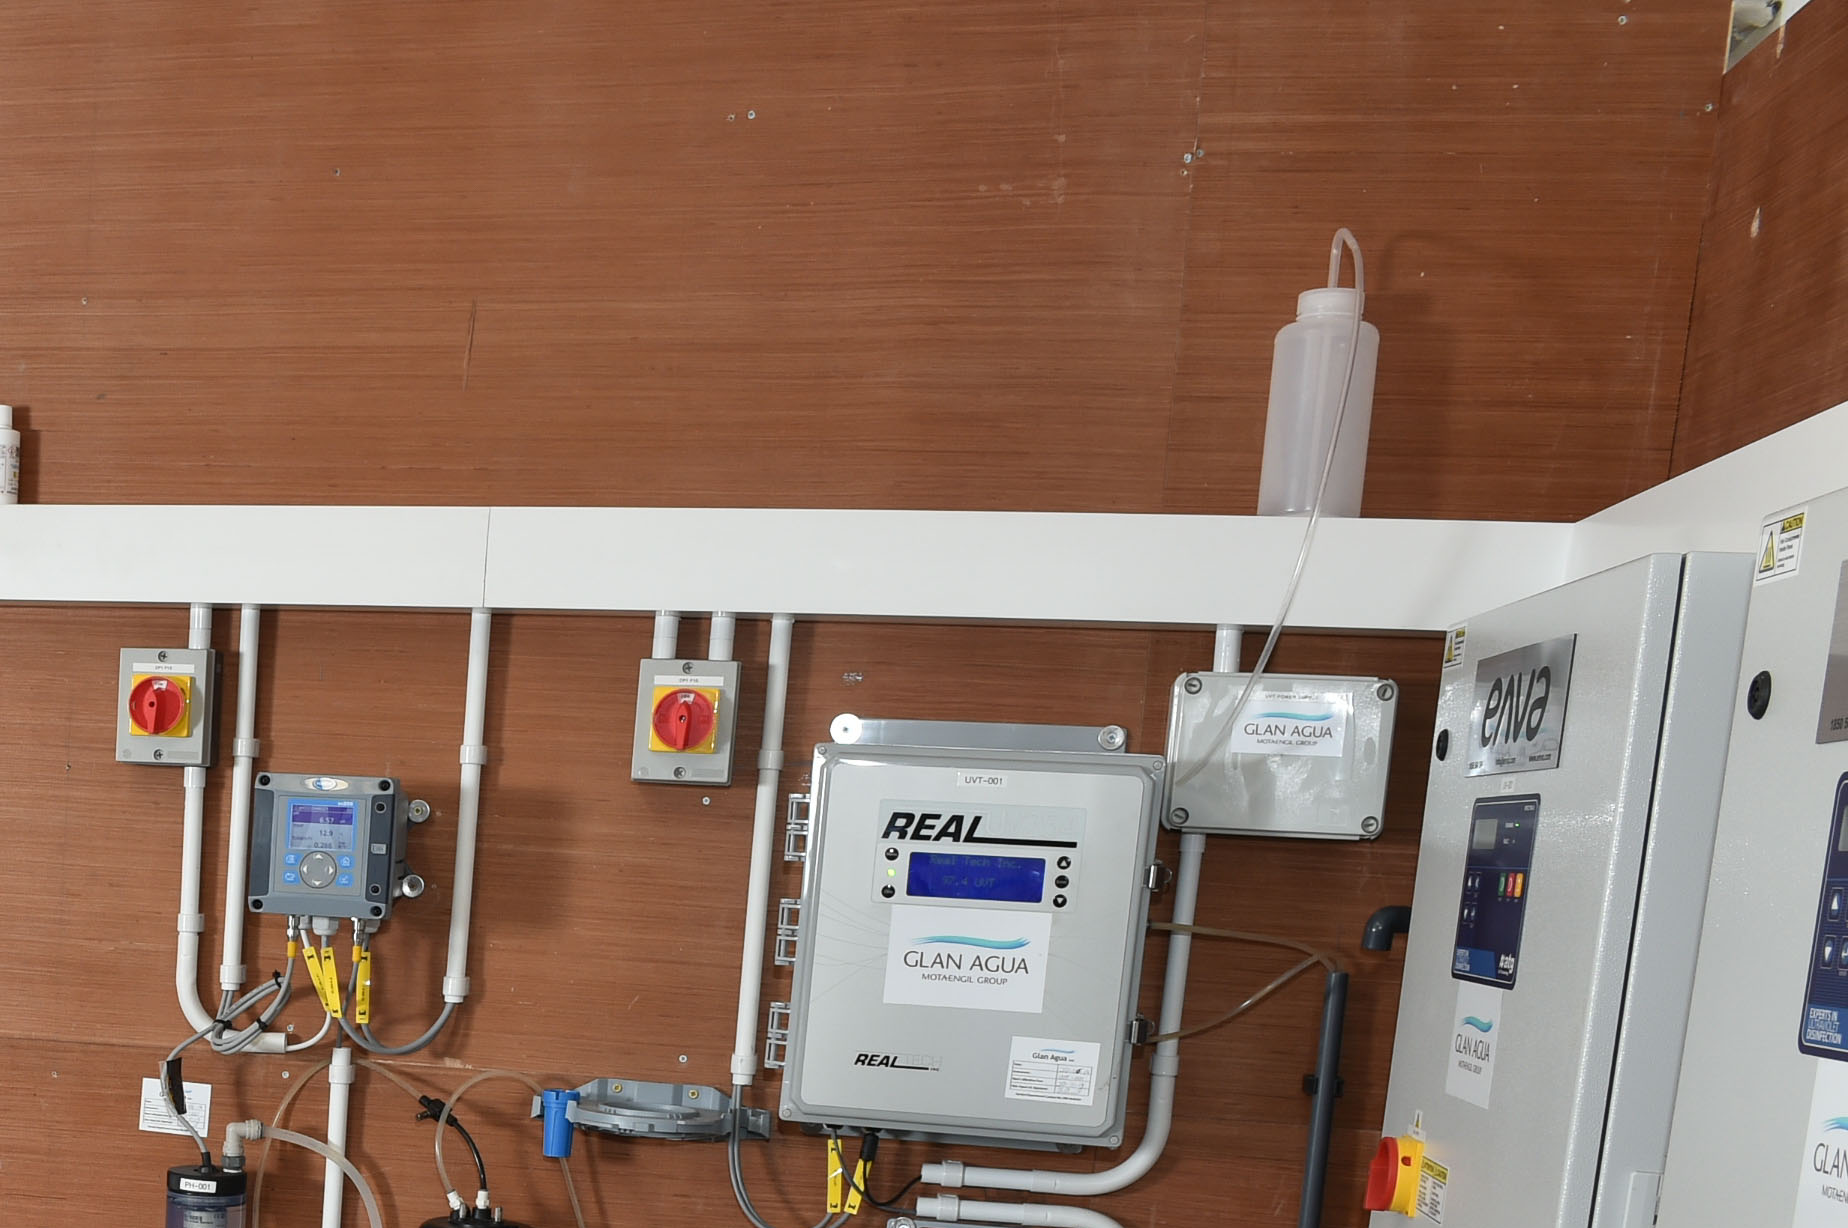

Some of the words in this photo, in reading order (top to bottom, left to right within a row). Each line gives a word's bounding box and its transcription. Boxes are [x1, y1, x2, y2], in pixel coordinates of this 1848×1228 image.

[1481, 665, 1551, 748] enva
[1244, 723, 1286, 736] GLAN
[1290, 725, 1333, 738] AGUA
[964, 775, 1003, 785] UVT-001
[930, 854, 956, 865] Real
[964, 856, 991, 866] Tech
[903, 950, 962, 970] GLAN
[969, 954, 1029, 974] AGUA
[977, 976, 1008, 985] GROUP
[184, 1181, 211, 1190] PH-001
